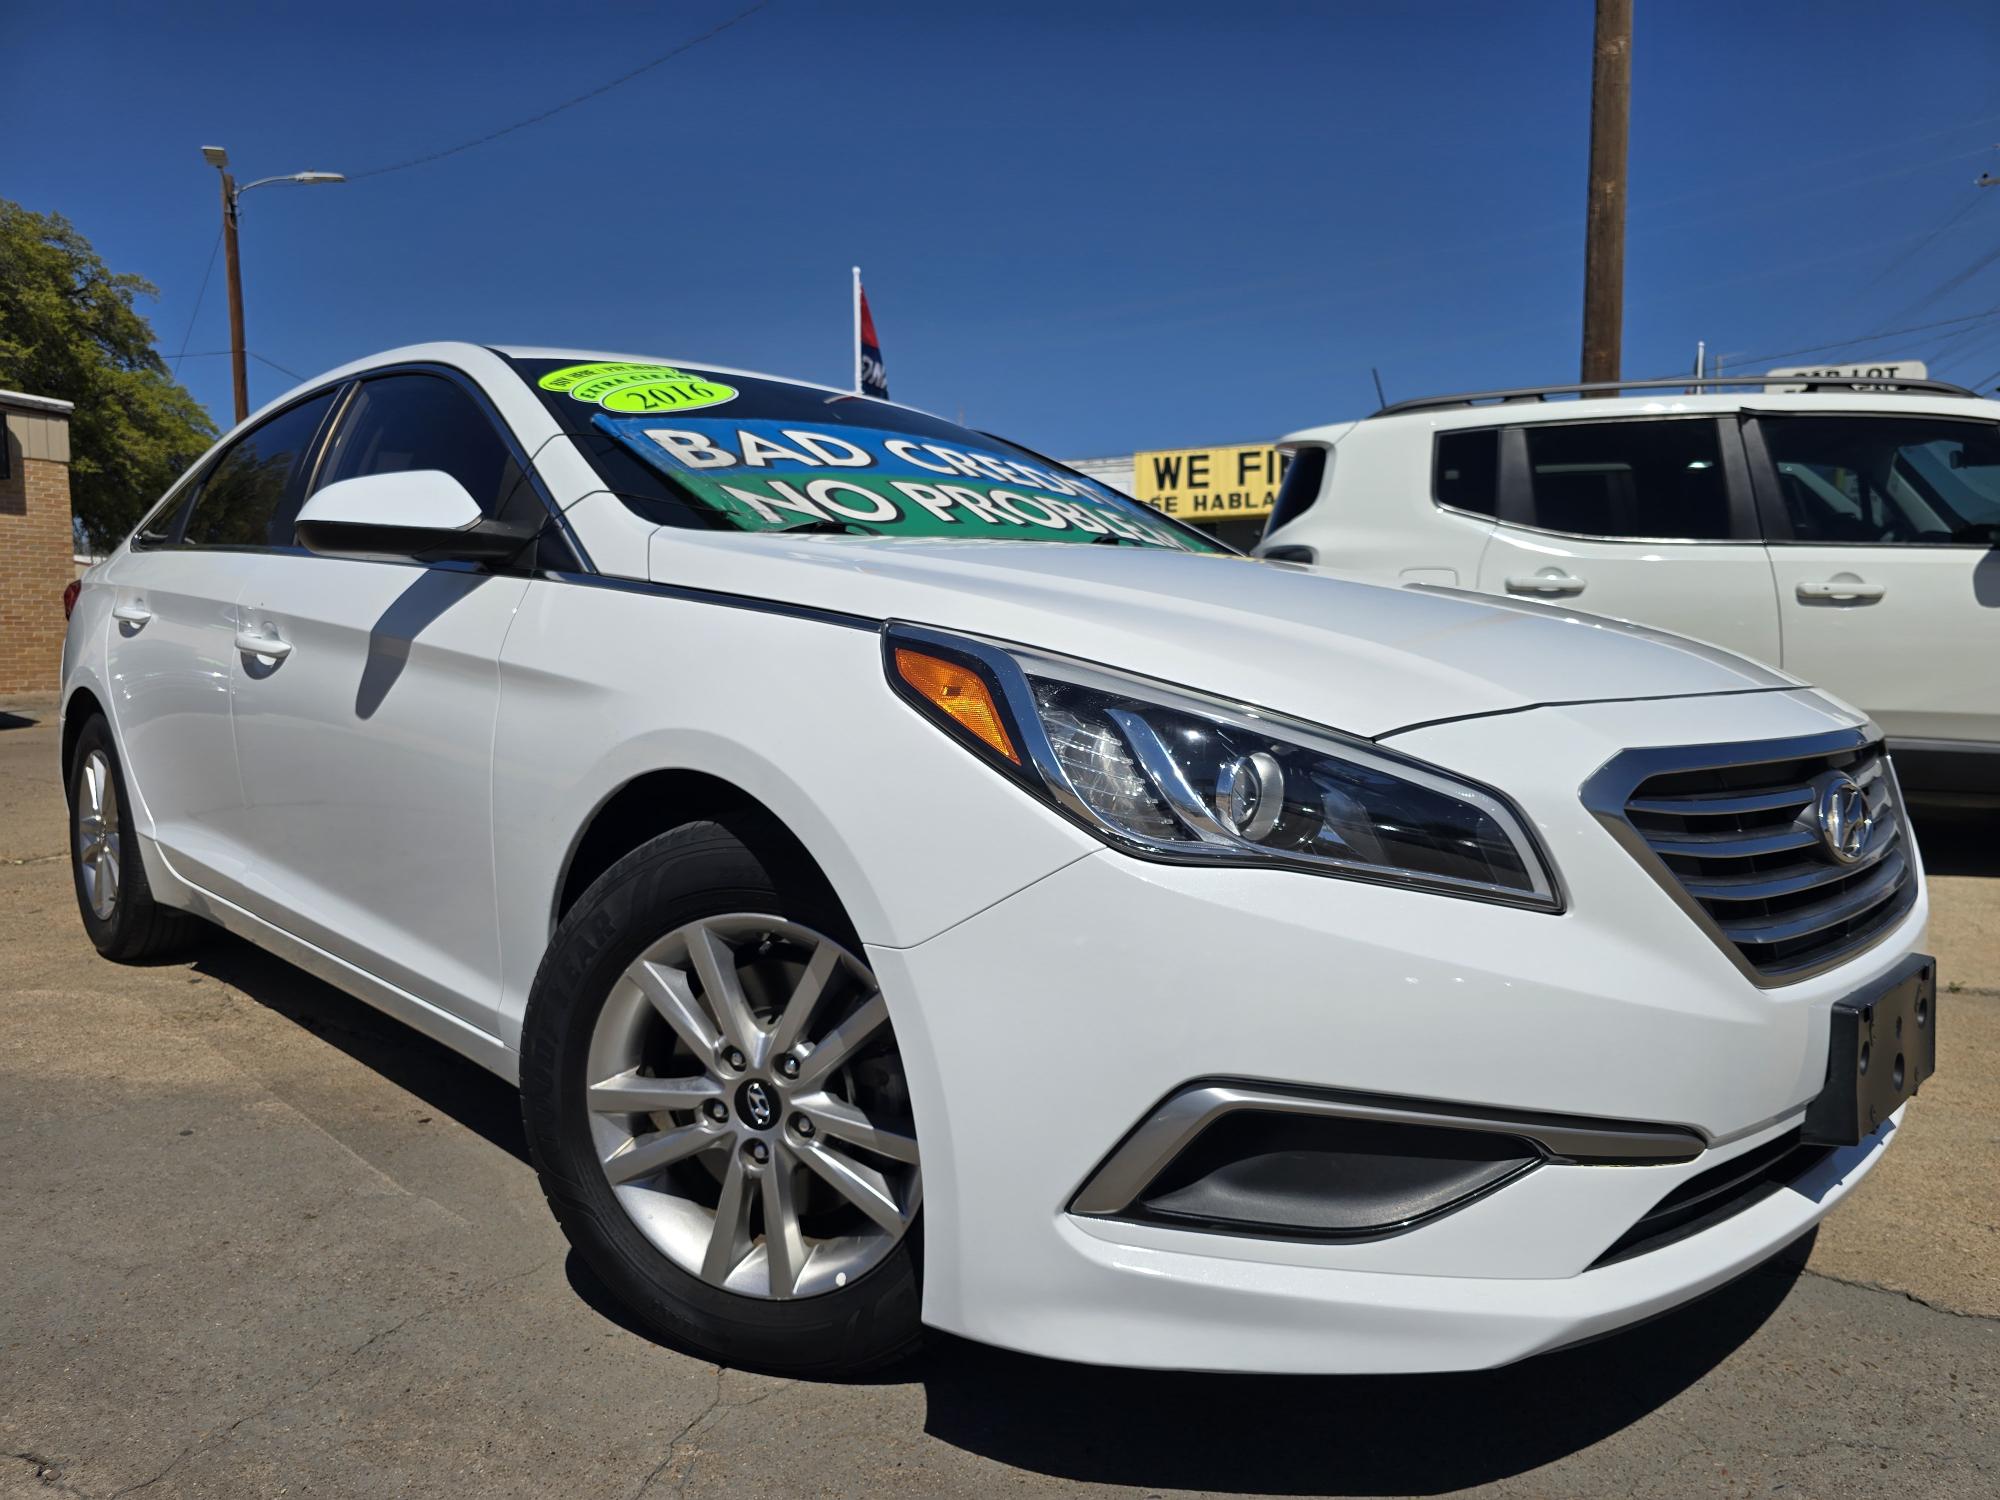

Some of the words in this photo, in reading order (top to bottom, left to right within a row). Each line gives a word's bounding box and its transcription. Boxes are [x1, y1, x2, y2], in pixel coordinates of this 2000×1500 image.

[580, 377, 630, 399] EXTRA
[626, 383, 715, 410] 2016
[641, 429, 872, 468] BAD
[1153, 454, 1210, 491] WE
[720, 479, 898, 524] NO
[1150, 496, 1179, 513] SE
[1193, 491, 1275, 512] HABLA
